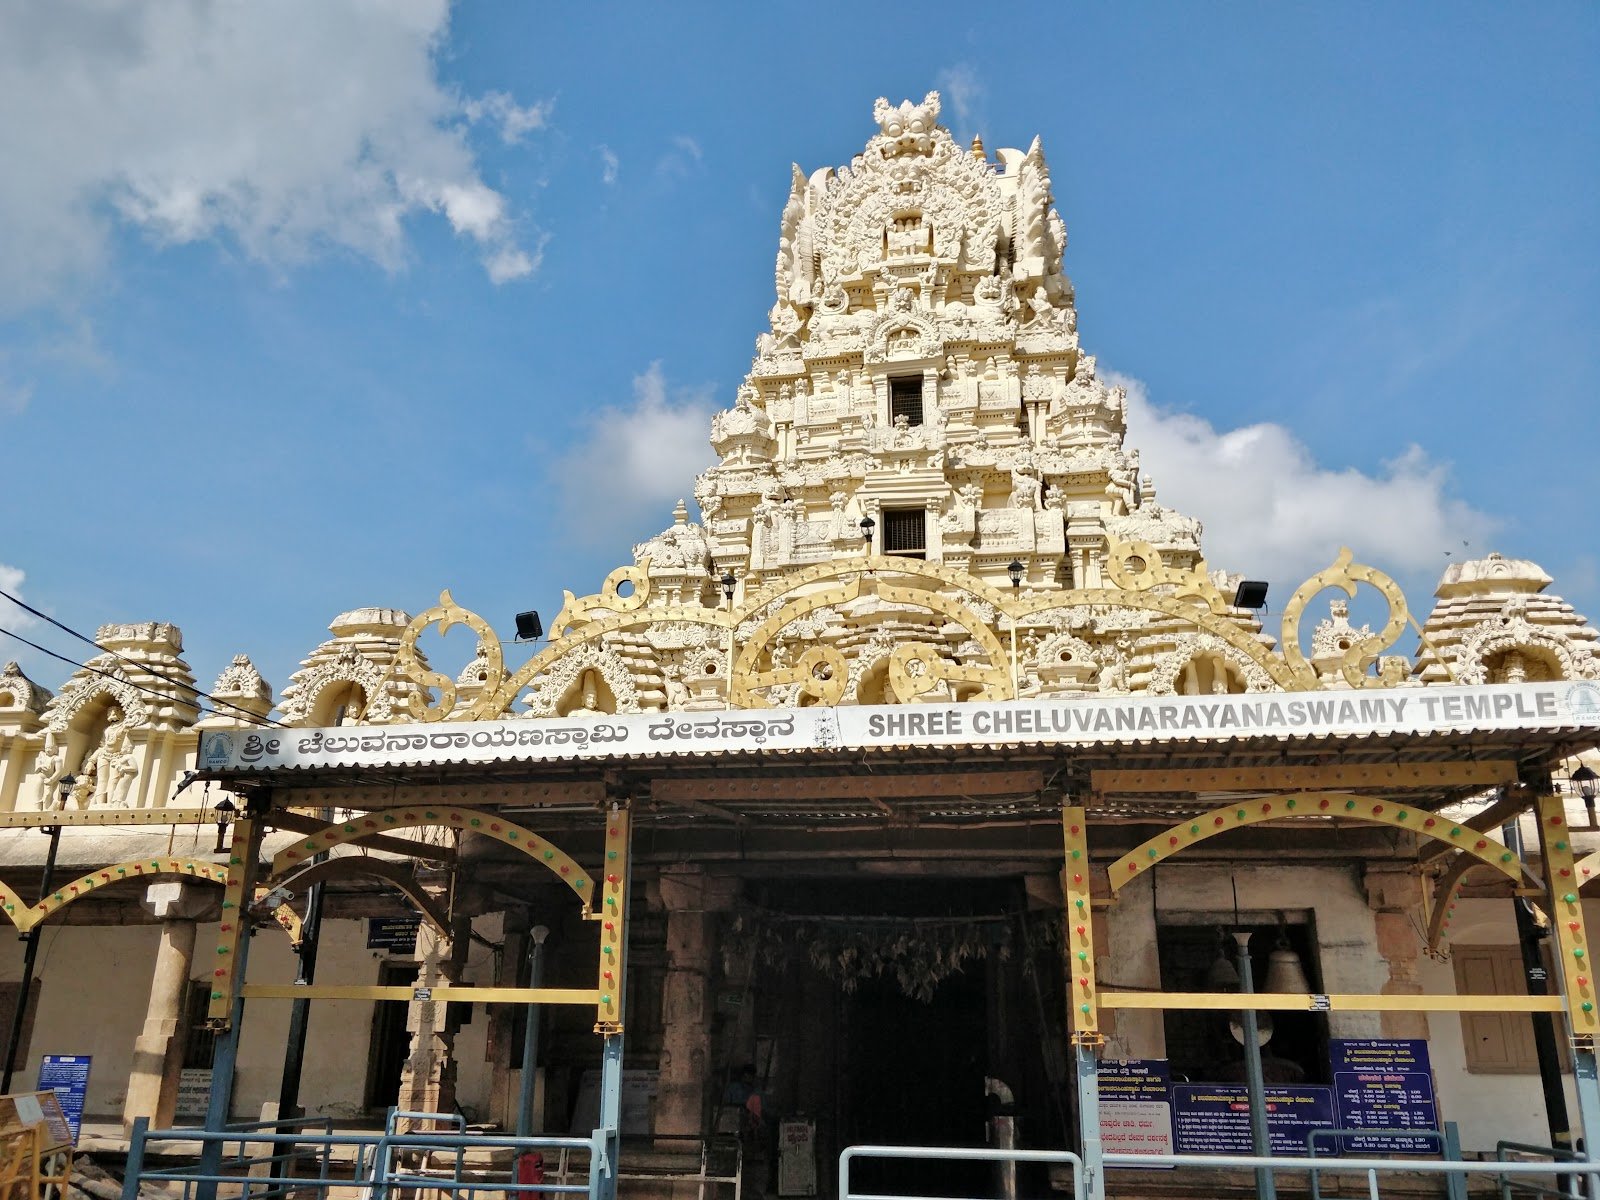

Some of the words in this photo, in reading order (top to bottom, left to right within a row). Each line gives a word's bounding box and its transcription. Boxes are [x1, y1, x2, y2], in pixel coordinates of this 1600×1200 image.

[868, 711, 962, 737] SHREE
[973, 697, 1408, 734] CHELUVANARAYANASWAMY
[1418, 692, 1558, 721] TEMPLE
[240, 735, 281, 763] ಶ್ರೀ
[298, 723, 629, 756] ಚೆಲುವನಾರಾಯಣಸ್ವಾಮಿ
[648, 714, 795, 744] ದೇವಸ್ಥಾನ
